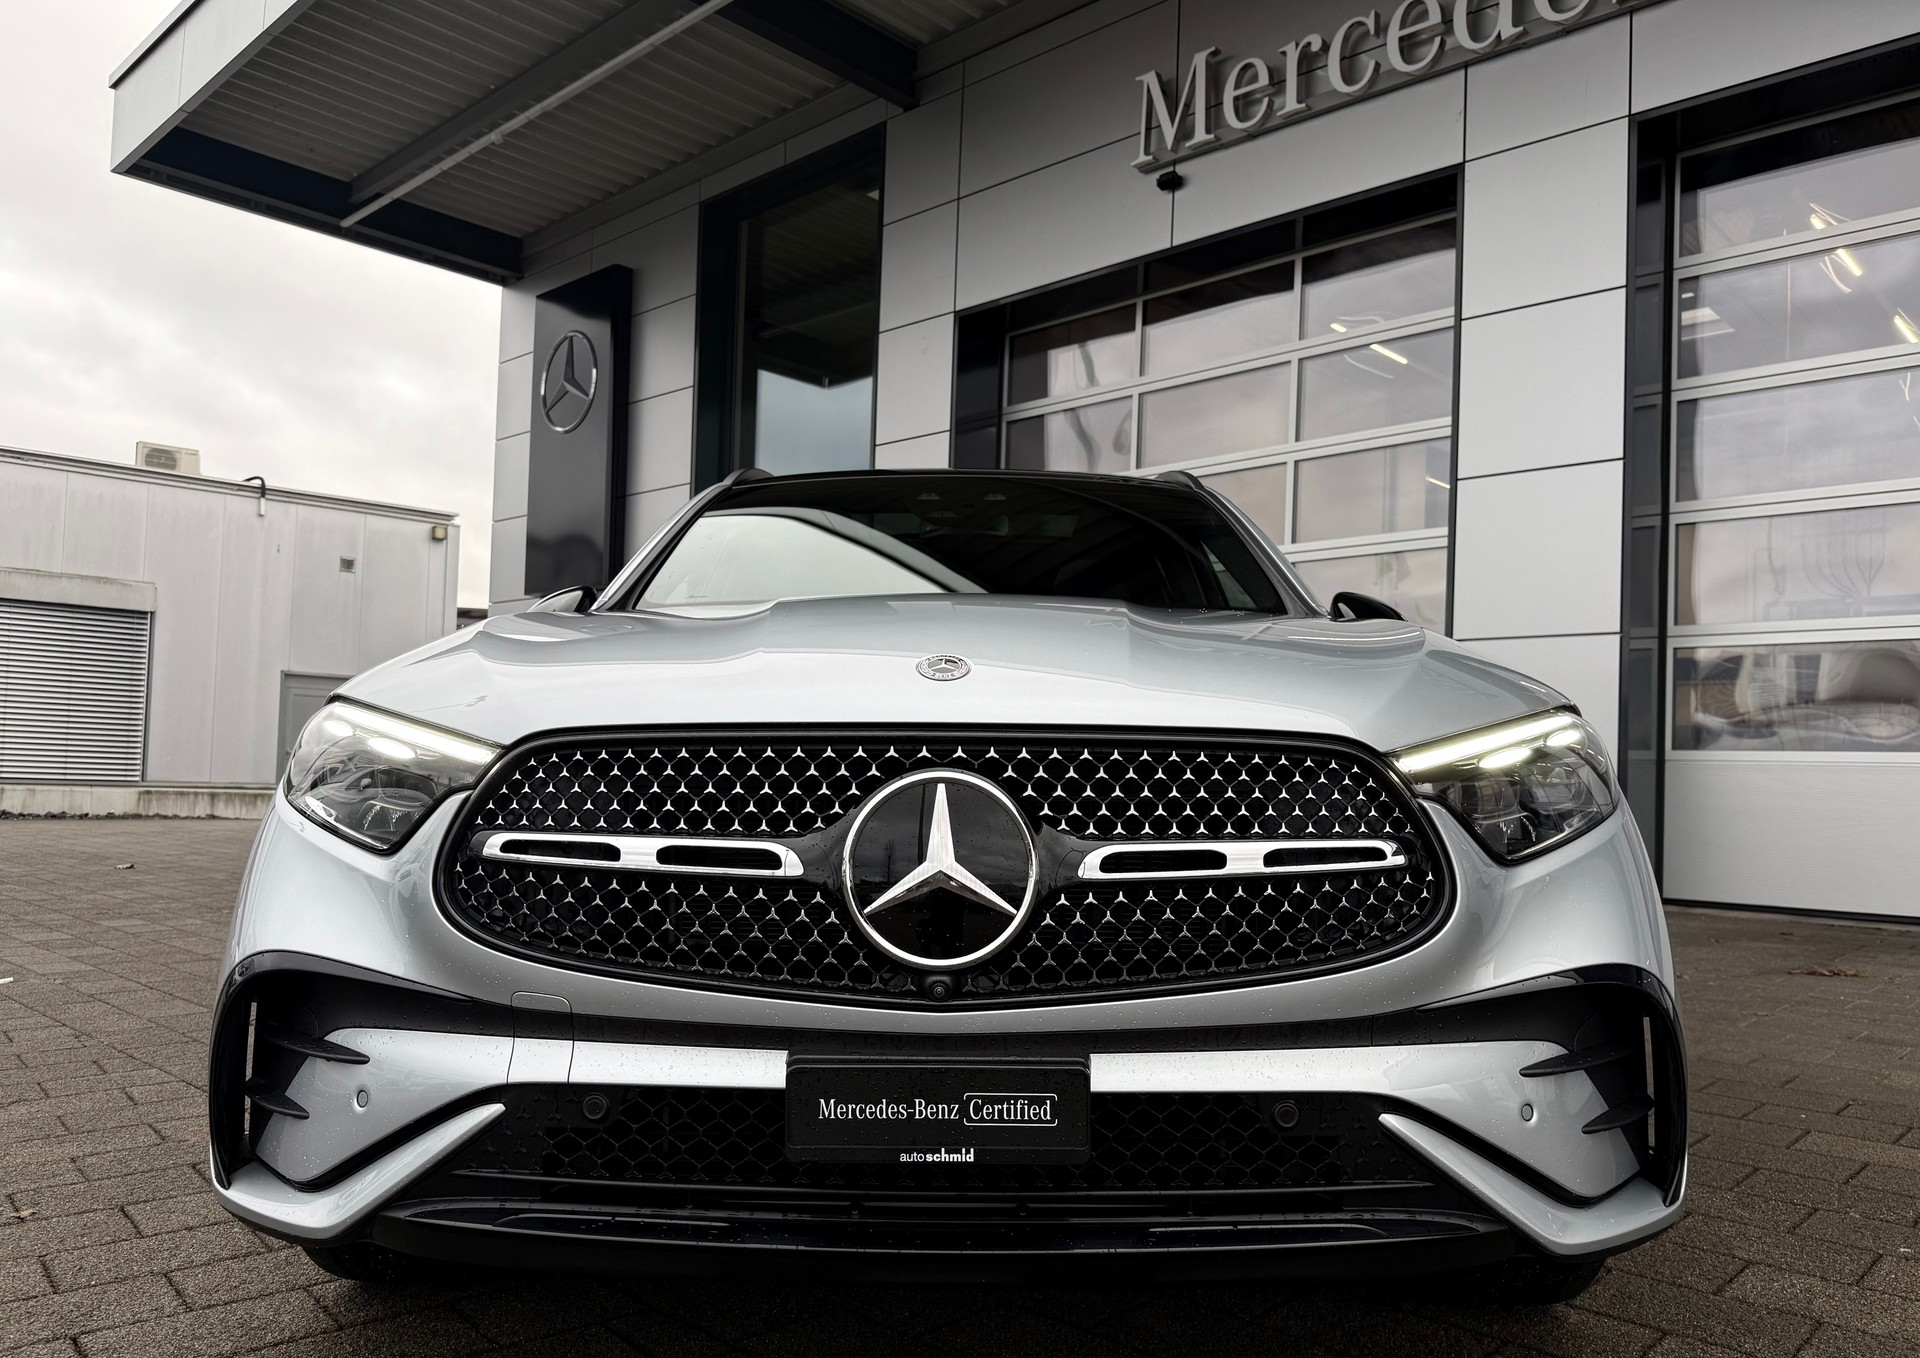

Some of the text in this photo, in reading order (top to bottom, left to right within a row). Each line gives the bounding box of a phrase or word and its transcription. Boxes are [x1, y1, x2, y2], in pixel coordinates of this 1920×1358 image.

[1131, 0, 1592, 170] Merced
[818, 1098, 1052, 1121] Mercedes-Benz Certified
